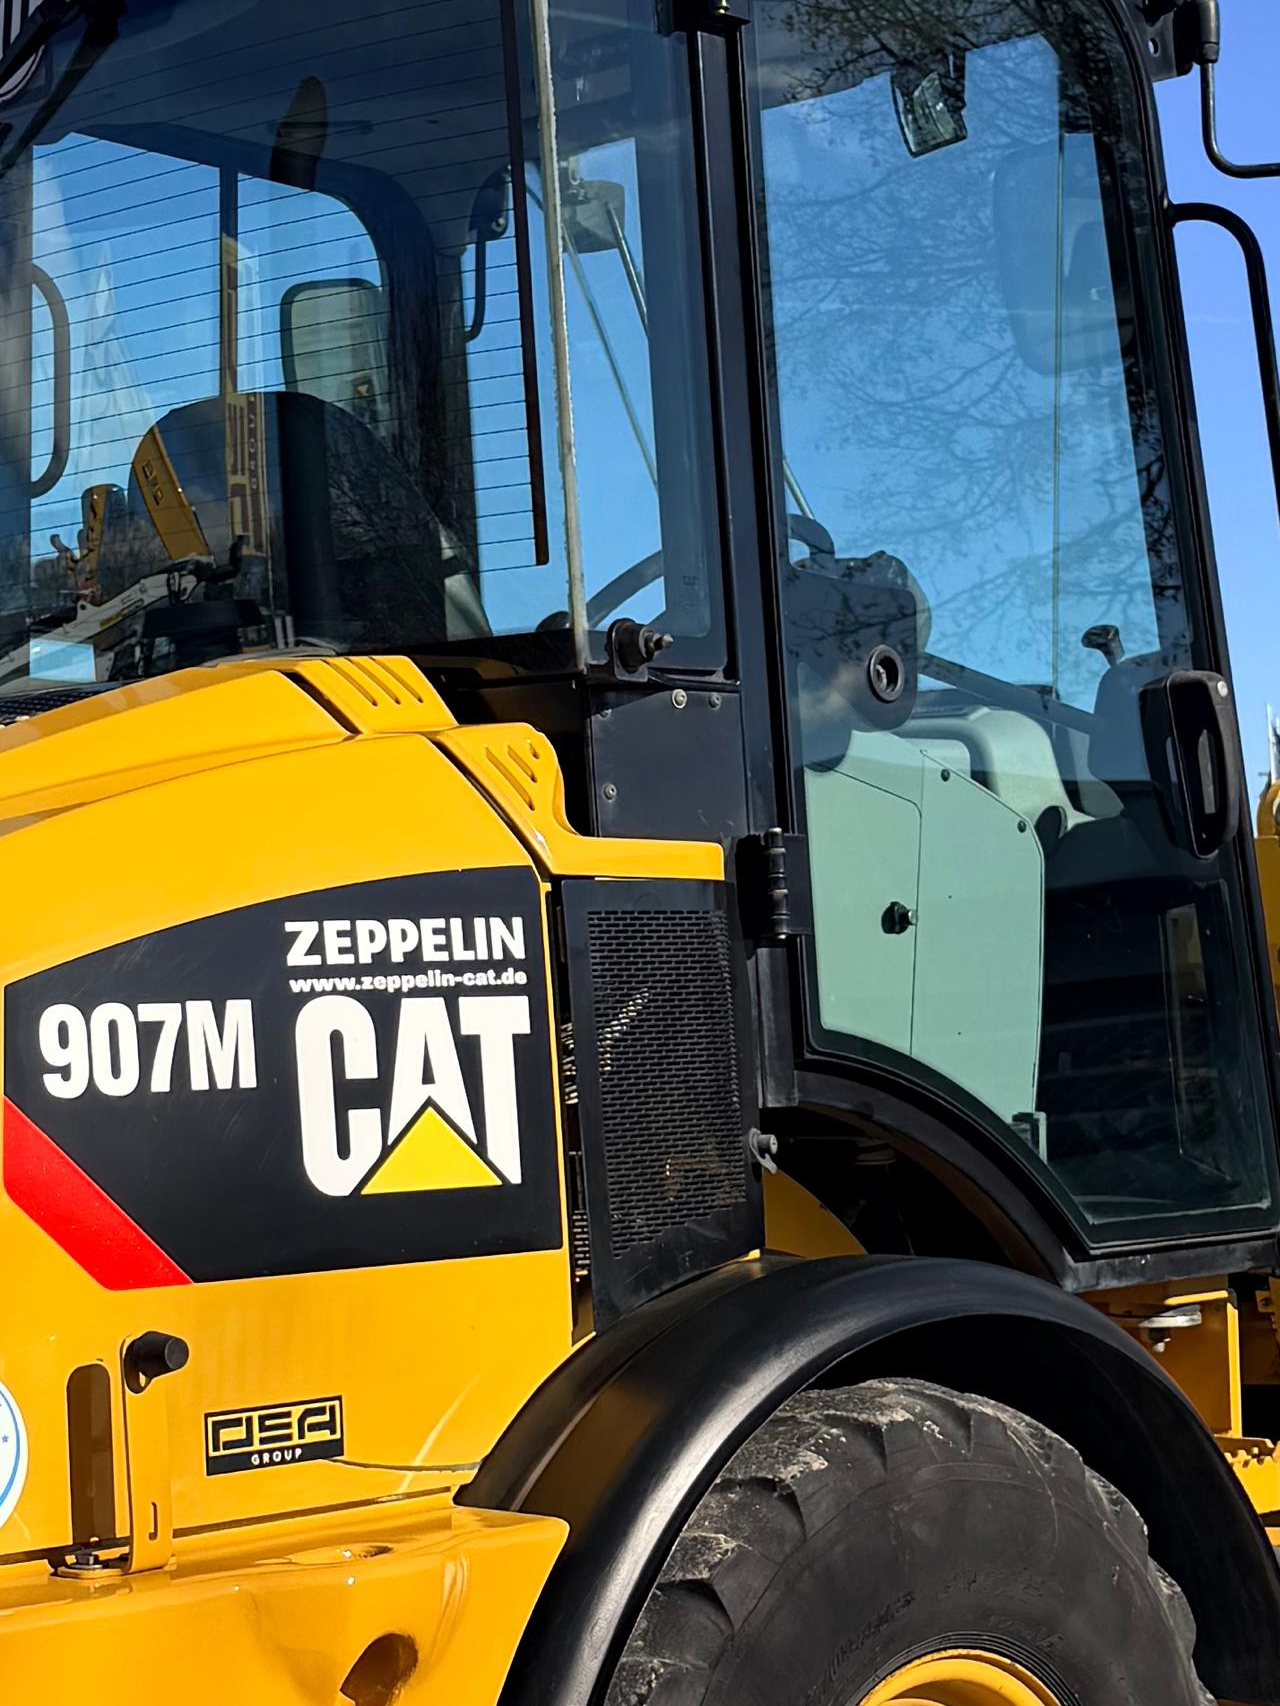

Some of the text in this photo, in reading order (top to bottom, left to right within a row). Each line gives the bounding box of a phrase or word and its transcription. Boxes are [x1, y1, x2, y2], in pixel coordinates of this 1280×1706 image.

[284, 917, 526, 966] ZEPPELIN
[289, 967, 528, 993] www.zeppelin-cat.de
[37, 999, 257, 1099] 907M
[295, 995, 531, 1197] CAT
[251, 1448, 302, 1466] GROUP
